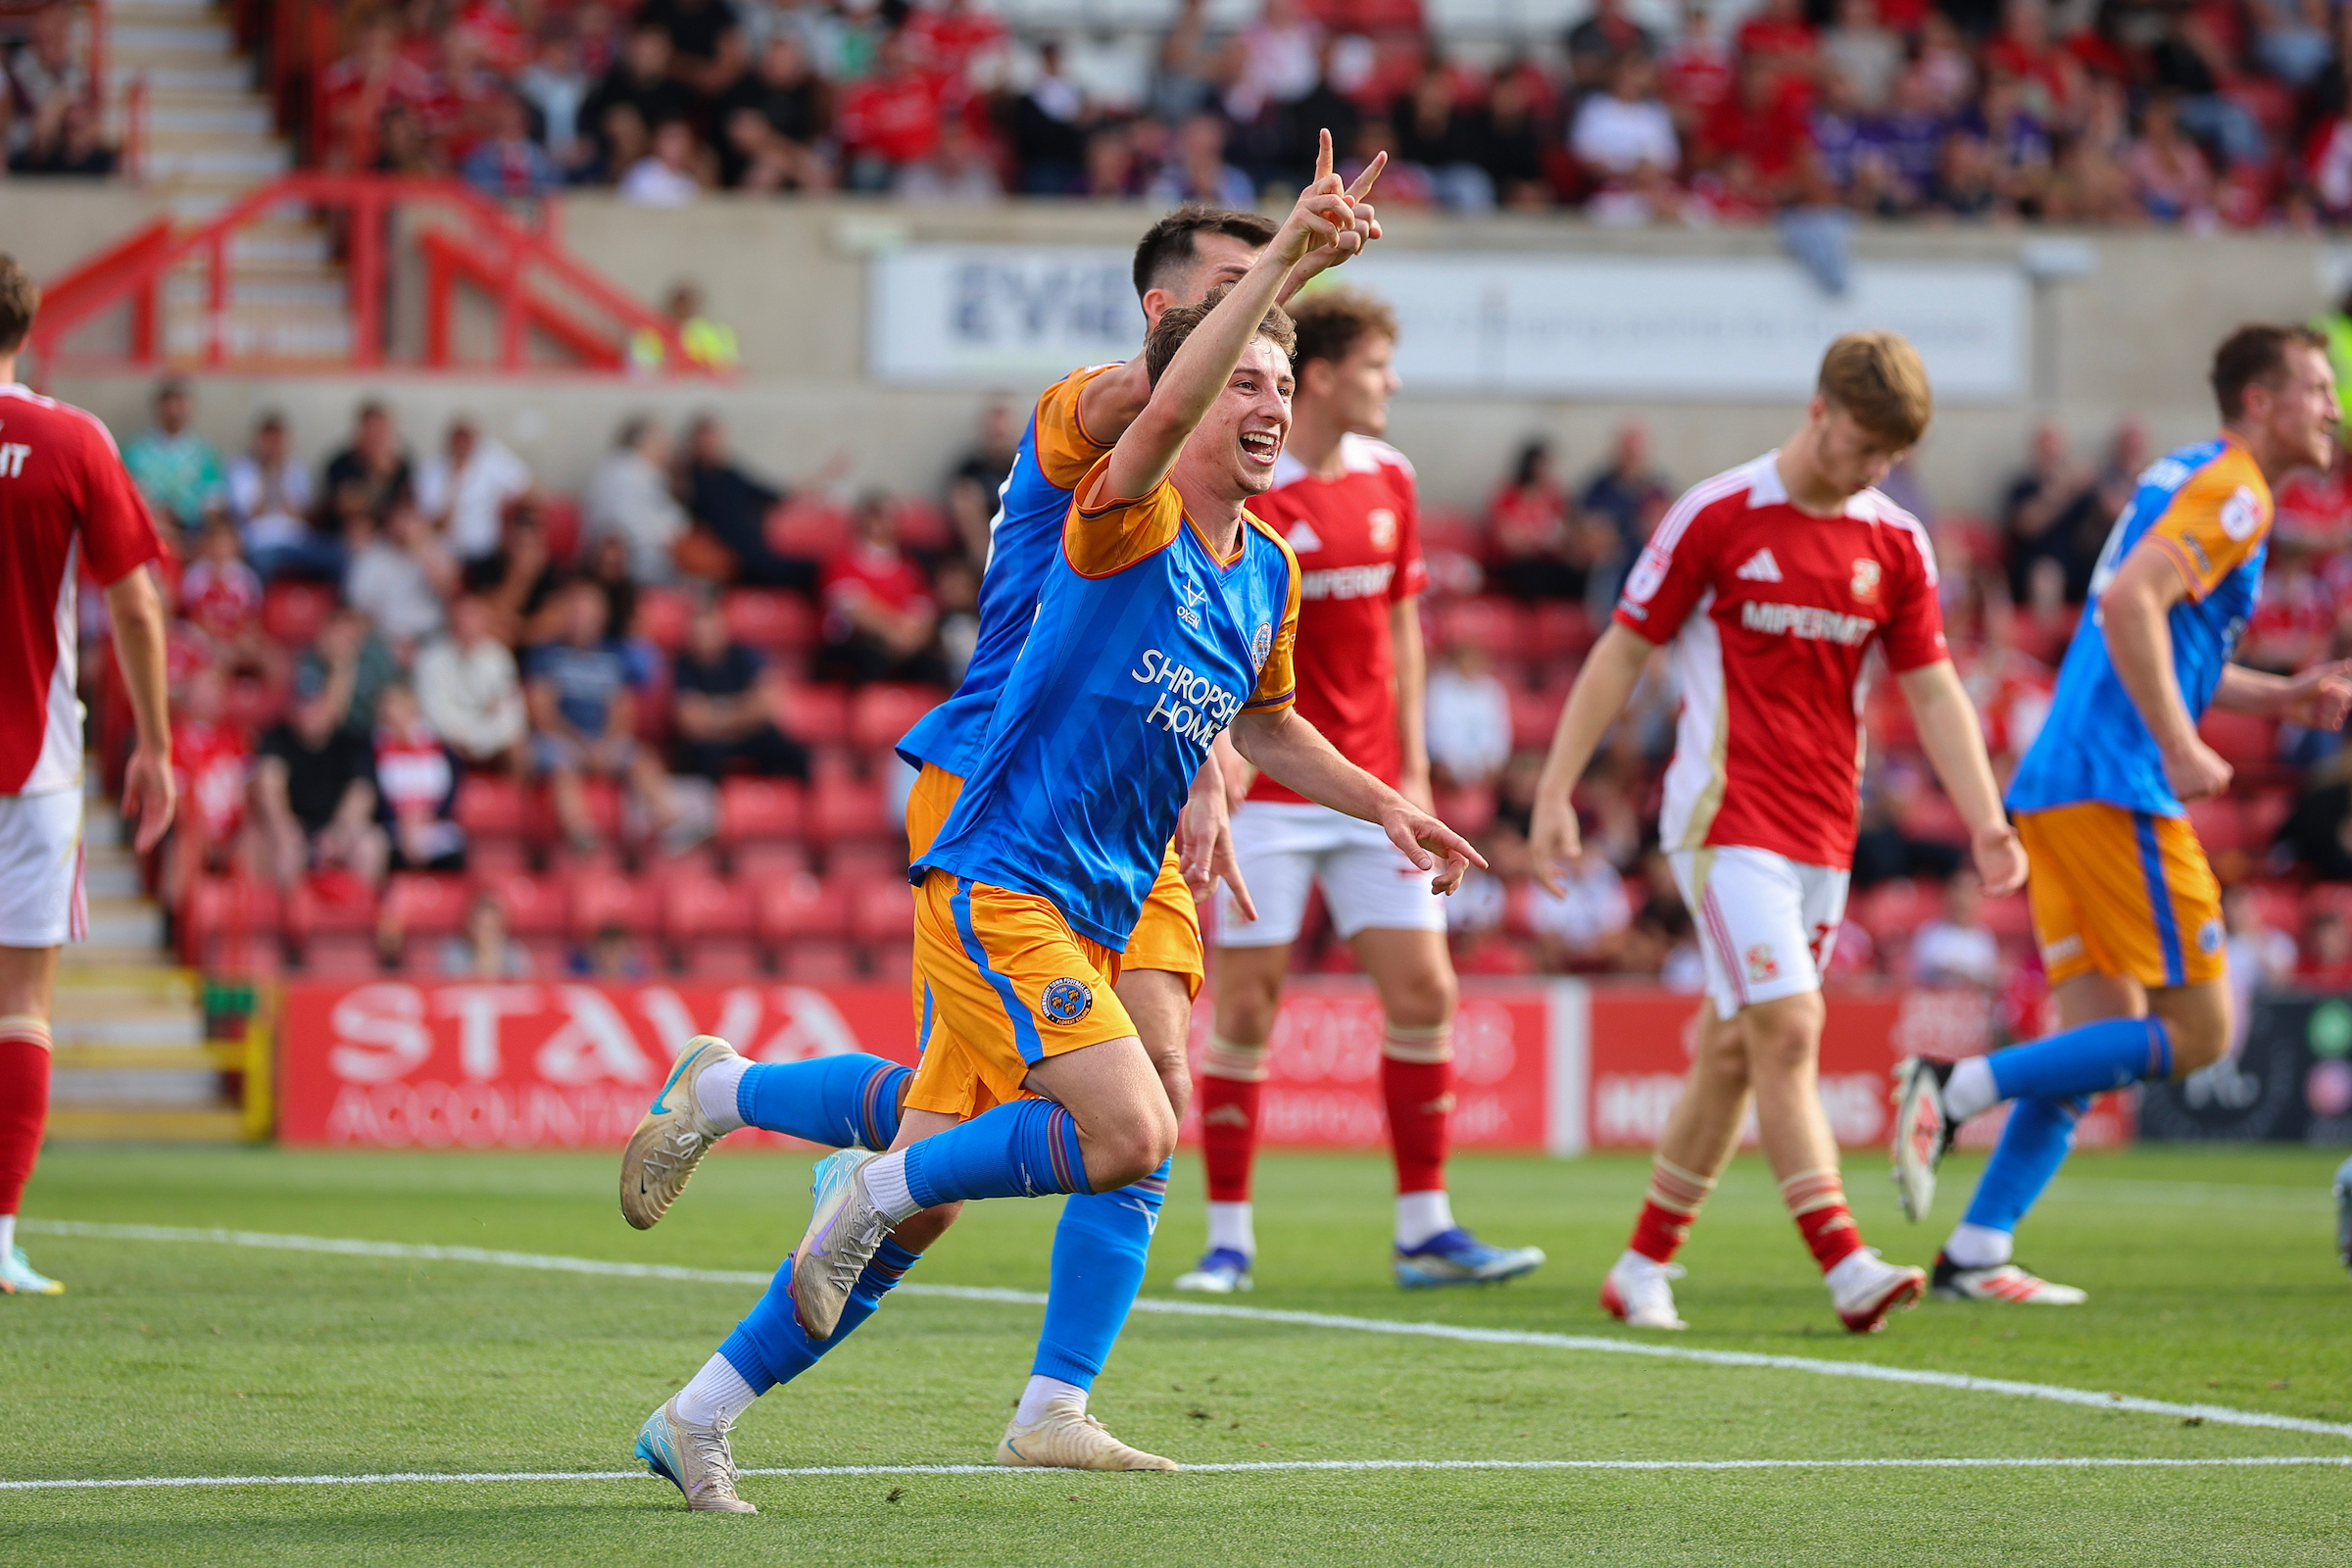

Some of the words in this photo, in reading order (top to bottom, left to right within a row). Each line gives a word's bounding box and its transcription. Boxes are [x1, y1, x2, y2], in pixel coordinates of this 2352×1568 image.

[1177, 606, 1200, 630] OXEN
[1146, 692, 1222, 757] HOME
[328, 982, 868, 1086] STAVA
